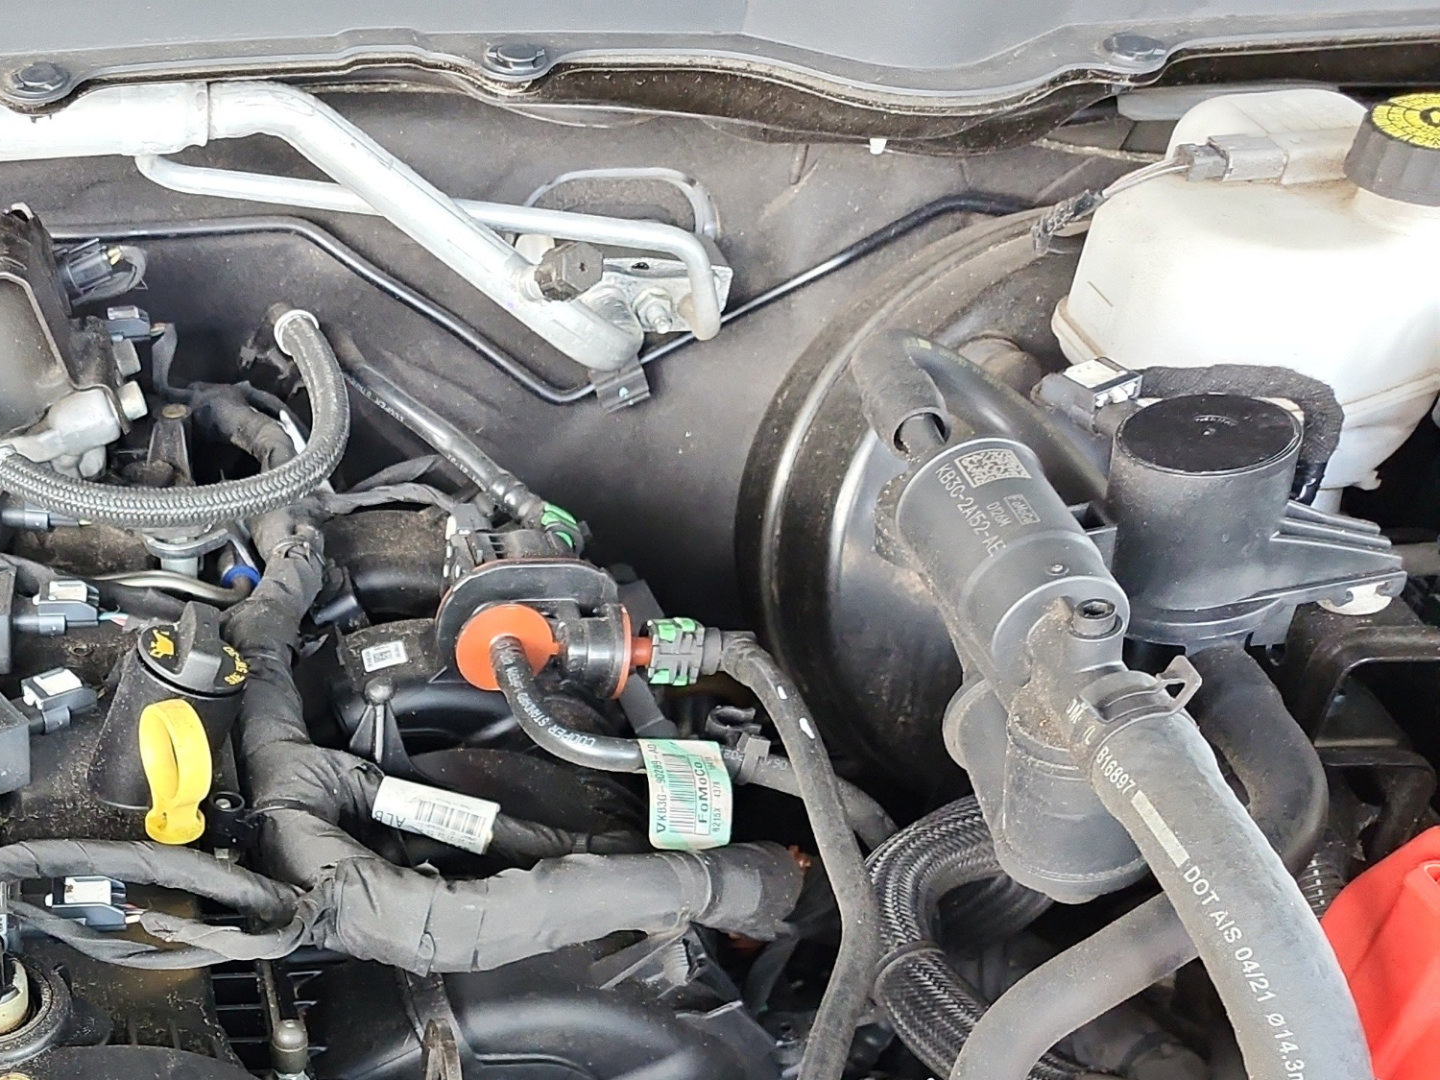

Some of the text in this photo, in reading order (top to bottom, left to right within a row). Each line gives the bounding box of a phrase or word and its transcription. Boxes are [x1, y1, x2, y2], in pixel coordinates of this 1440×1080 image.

[693, 761, 709, 824] FoMoCo
[1183, 865, 1220, 905] DOT
[1234, 947, 1276, 1002] 04/21
